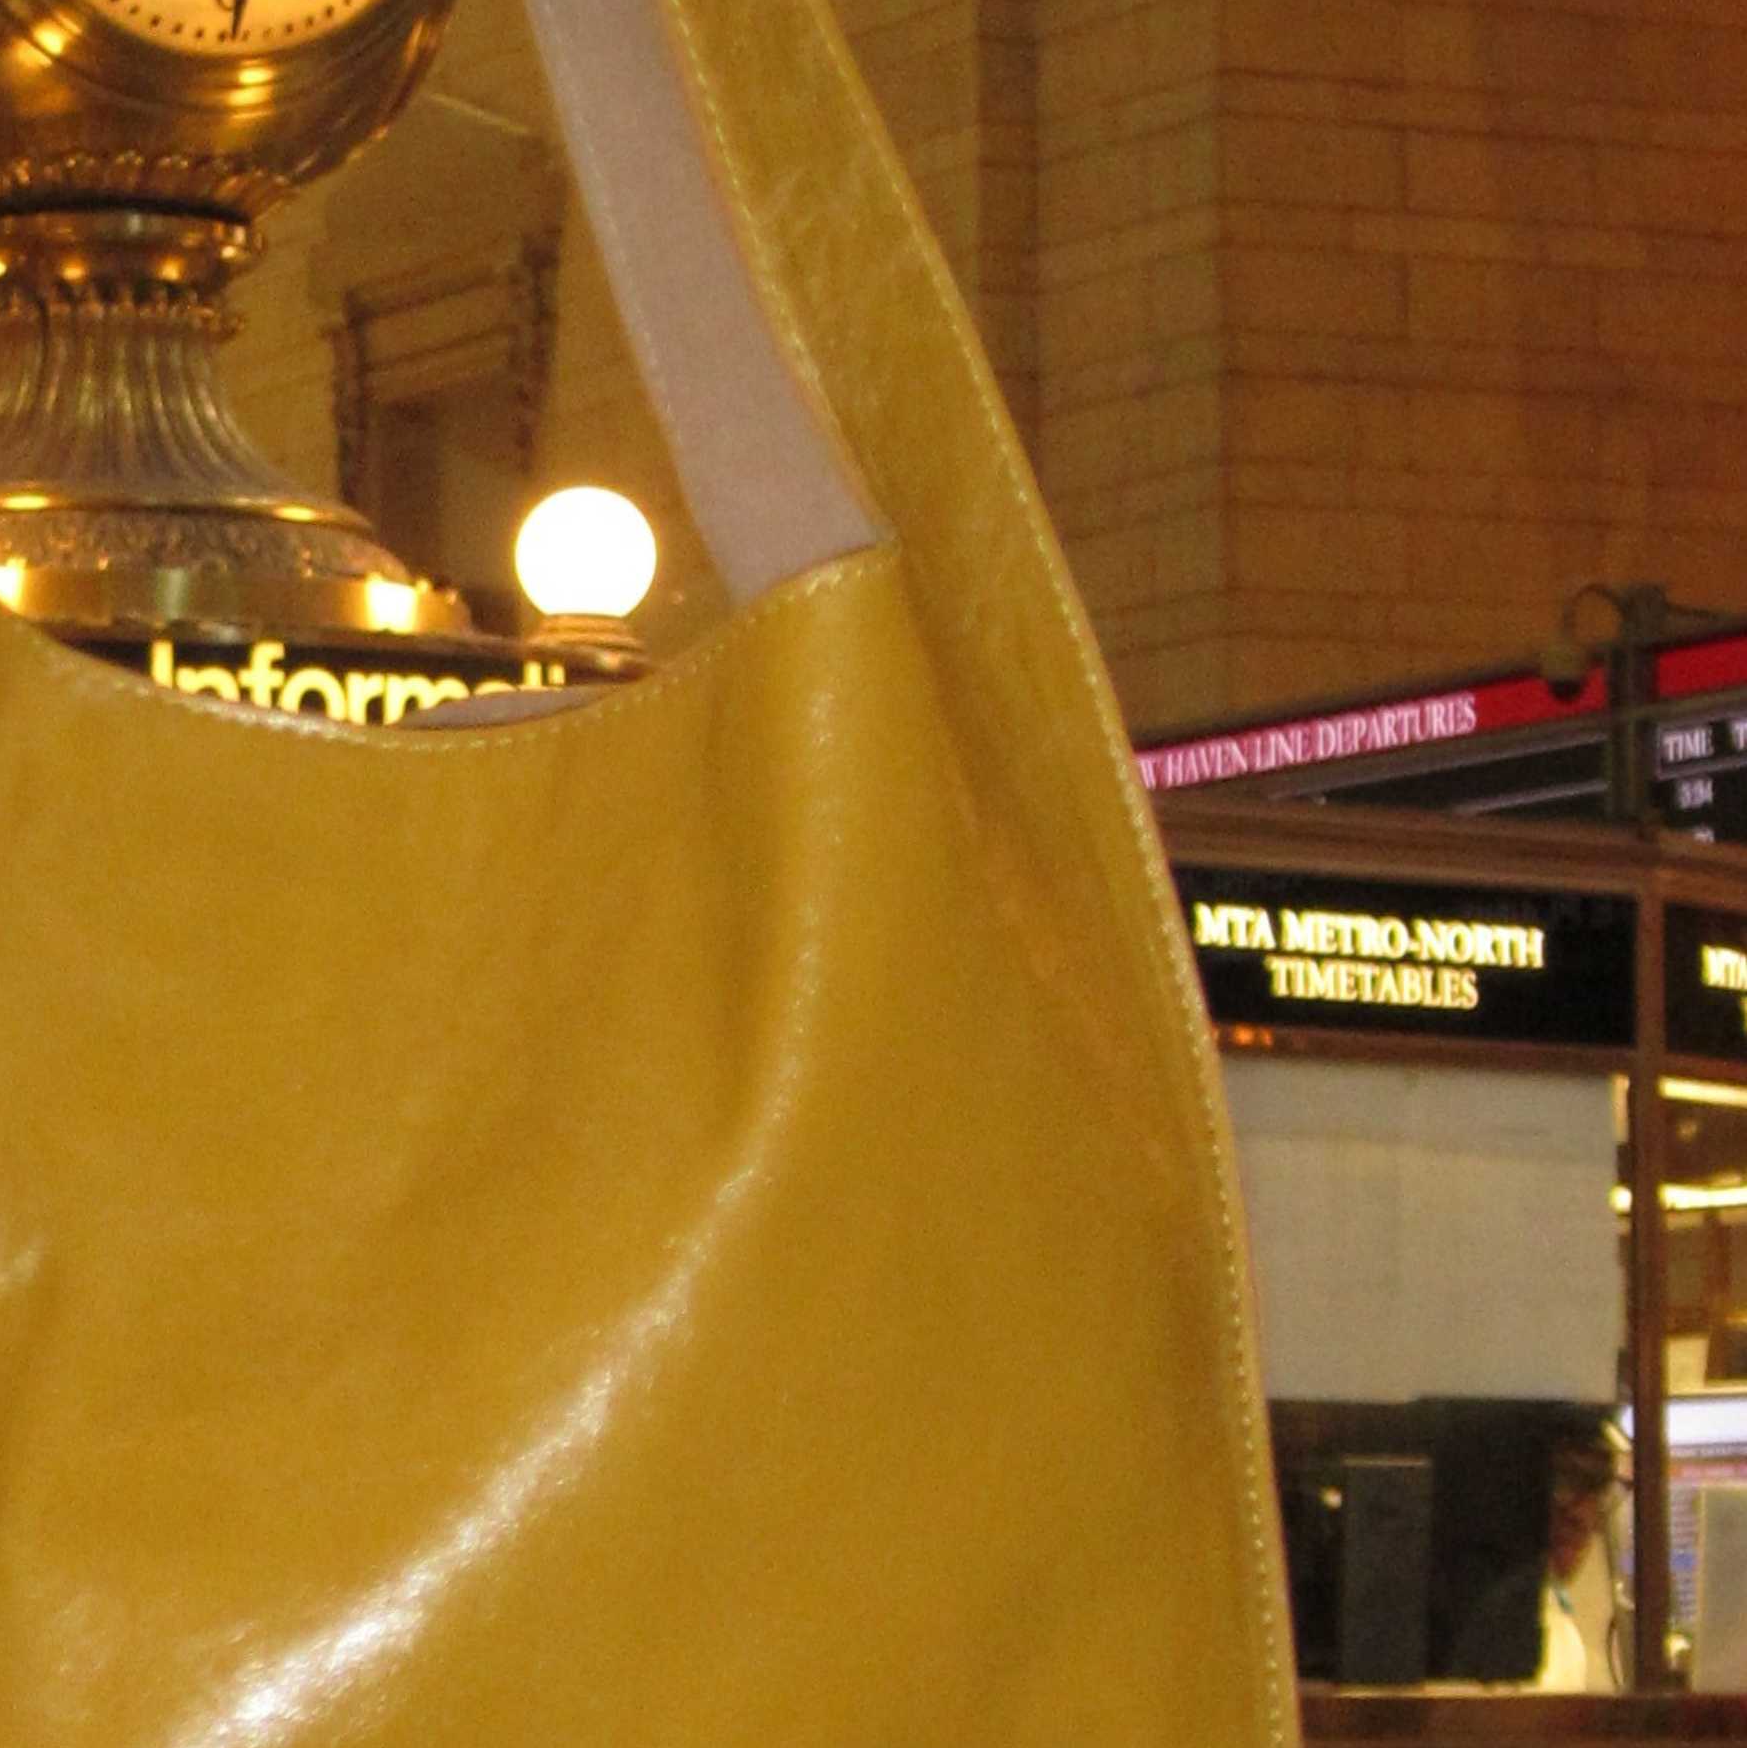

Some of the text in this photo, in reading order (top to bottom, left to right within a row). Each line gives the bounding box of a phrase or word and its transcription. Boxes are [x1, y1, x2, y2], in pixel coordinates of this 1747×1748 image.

[1164, 737, 1248, 789] HAVEN
[1250, 726, 1311, 773] LINE
[1315, 691, 1477, 761] DEPARTURES
[1194, 902, 1545, 969] MTA METRO-NORTH
[1264, 955, 1480, 1011] TIMETABLES
